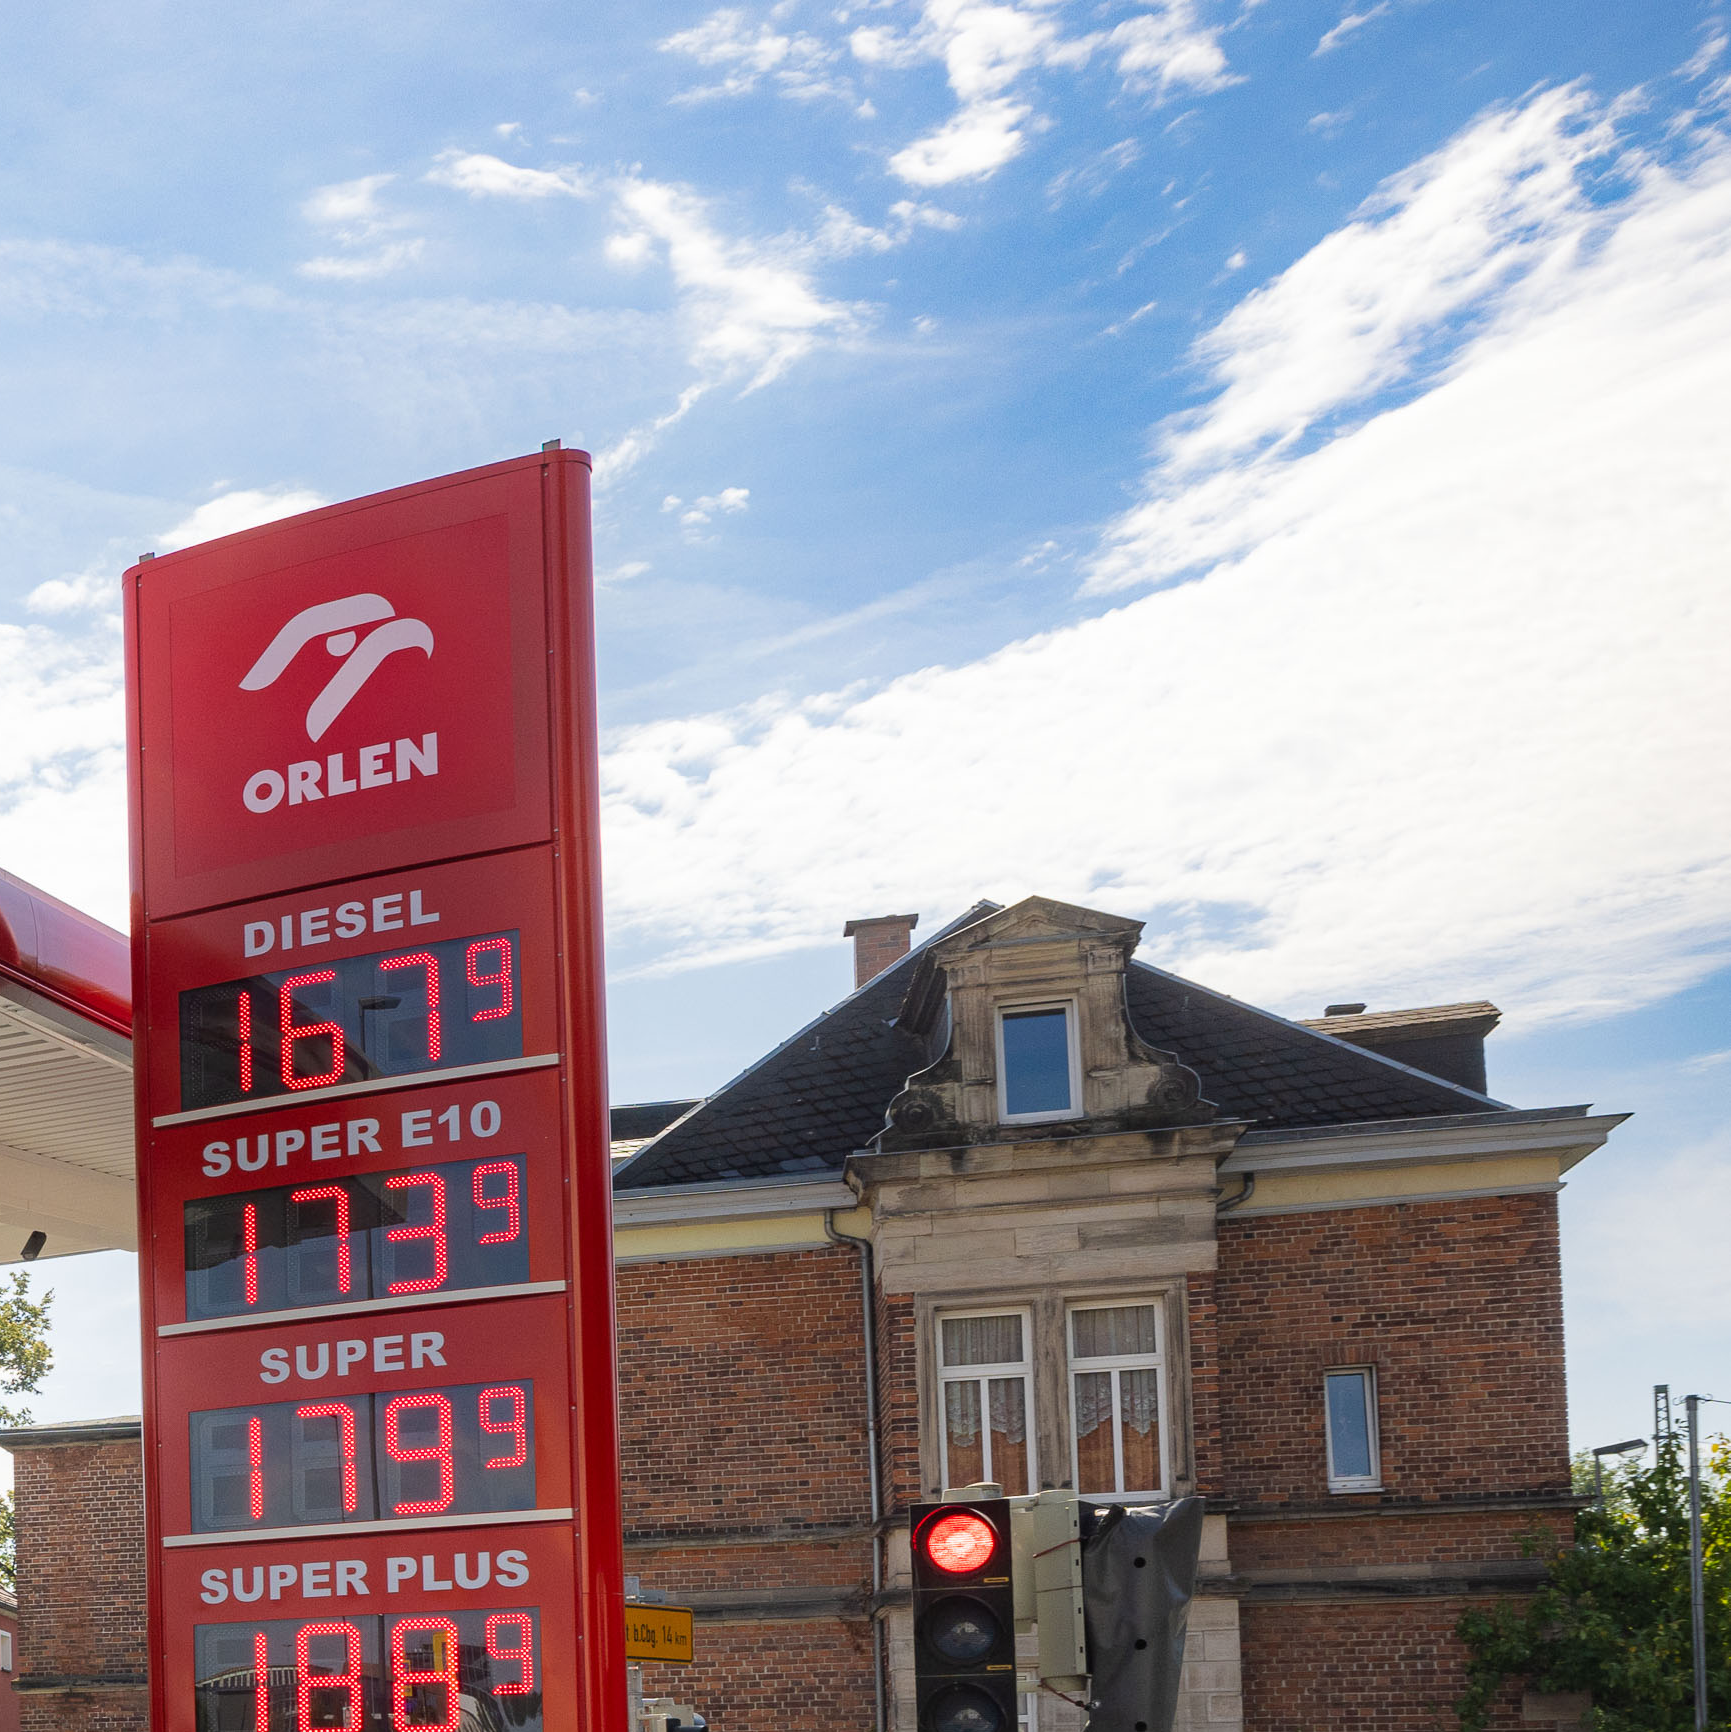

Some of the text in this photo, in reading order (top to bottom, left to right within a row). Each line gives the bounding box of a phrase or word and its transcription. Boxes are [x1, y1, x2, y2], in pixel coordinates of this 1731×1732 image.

[242, 731, 439, 814] ORLEN
[243, 890, 440, 958] DIESEL
[202, 1100, 502, 1178] SUPER E10
[259, 1331, 447, 1384] SUPER
[200, 1550, 530, 1605] SUPER PLUS
[662, 1625, 673, 1645] 14
[675, 1631, 687, 1646] km
